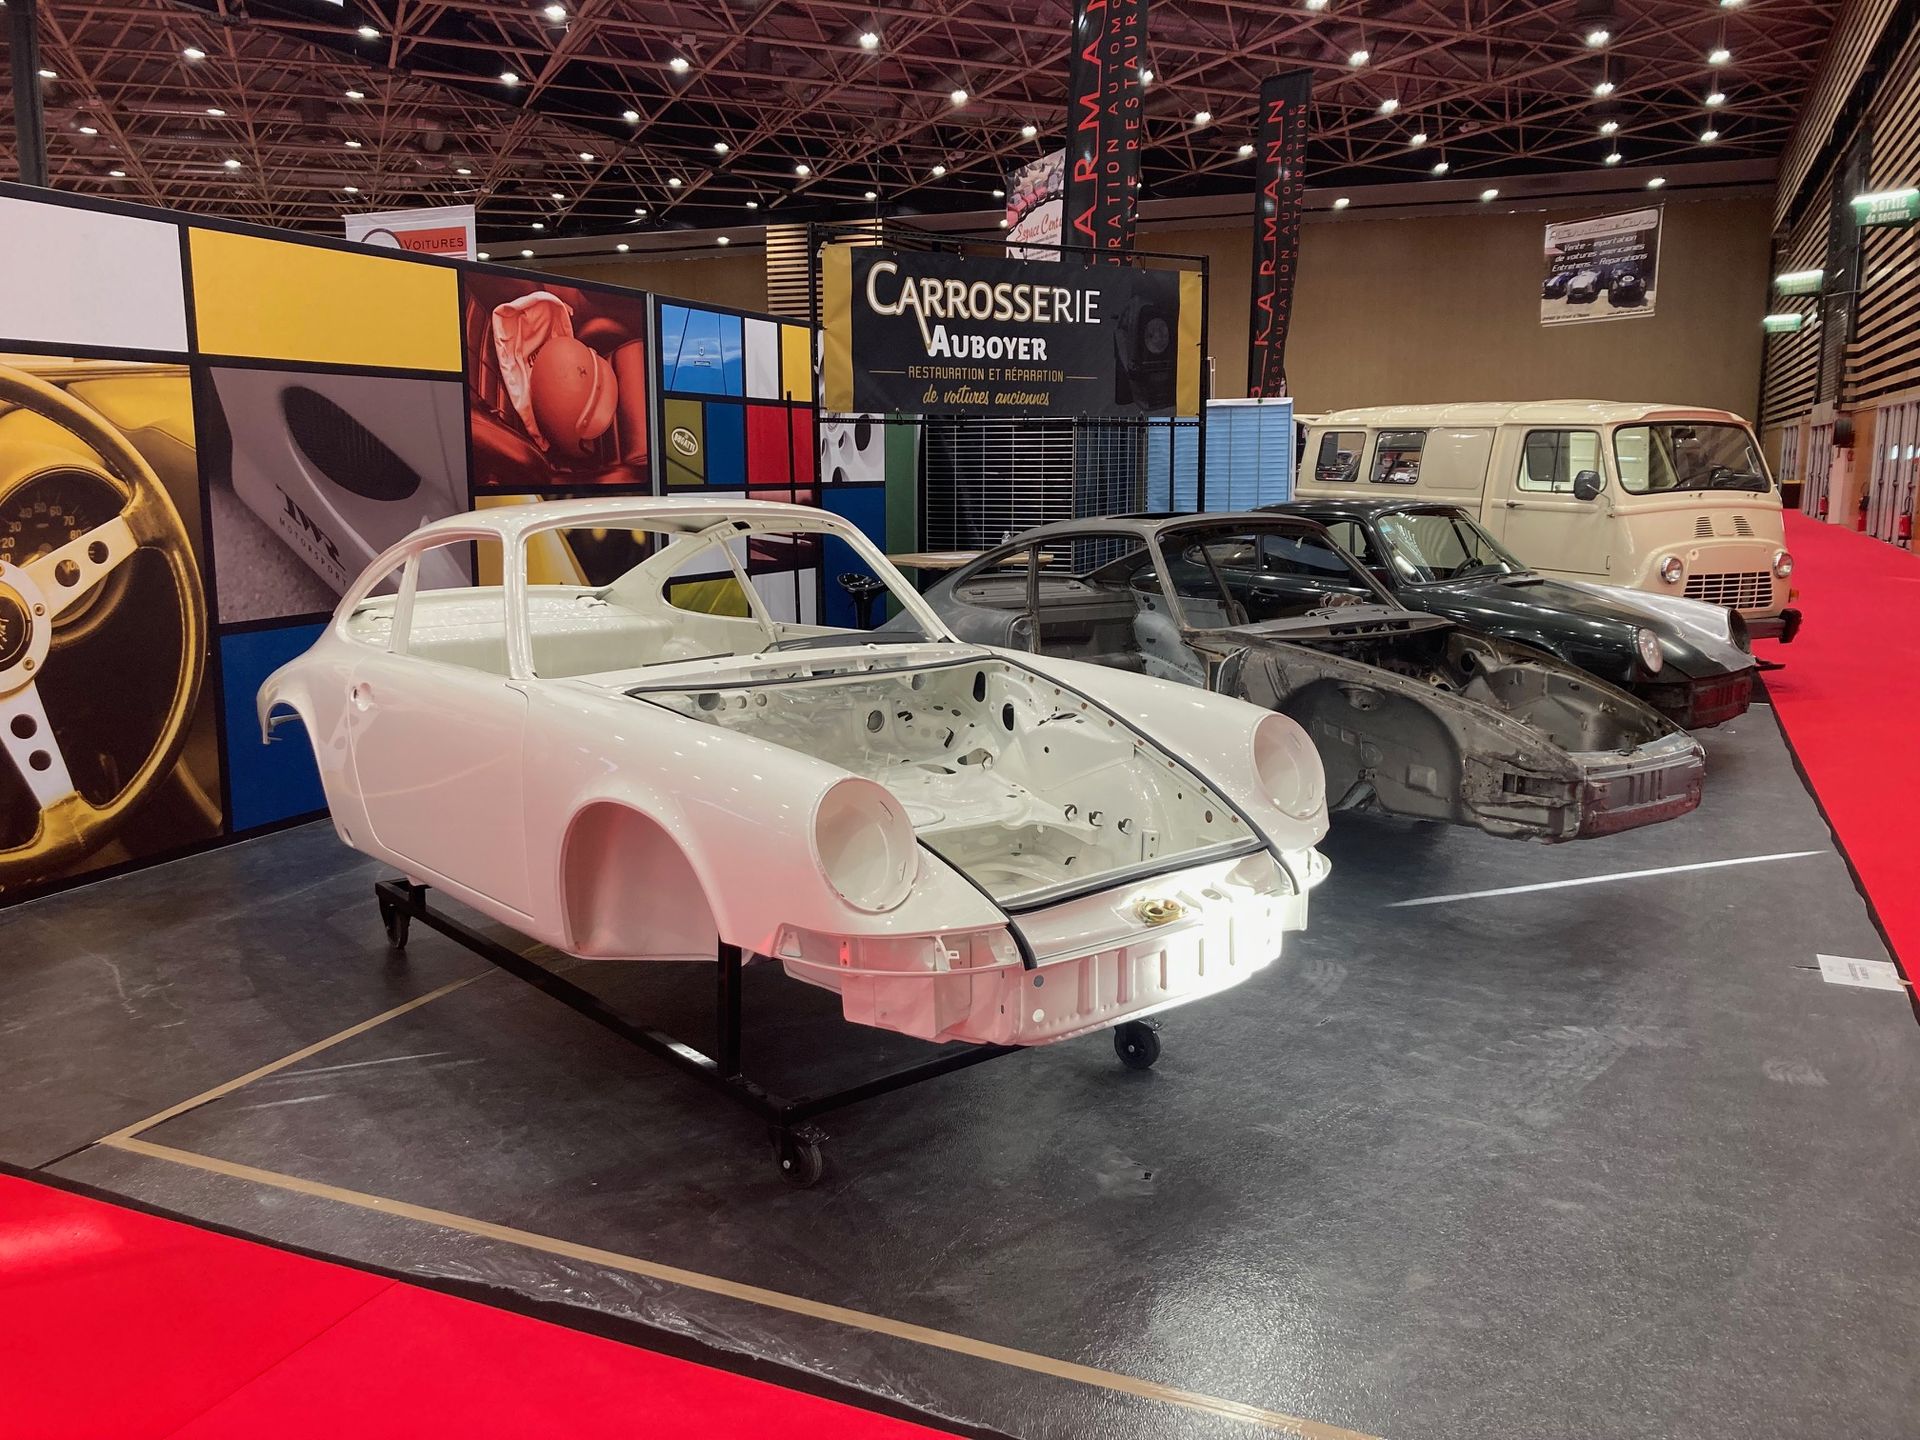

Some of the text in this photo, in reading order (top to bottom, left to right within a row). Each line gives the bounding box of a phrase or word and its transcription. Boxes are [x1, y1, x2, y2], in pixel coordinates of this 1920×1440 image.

[1041, 213, 1062, 234] Cent
[1254, 100, 1285, 346] KARMANN
[927, 325, 1047, 361] AUBOYER
[908, 366, 1064, 382] RESTAURATION ET RÉPARATION
[923, 384, 1050, 406] de voitures anciennes
[8, 521, 22, 533] 30
[63, 516, 75, 526] 70
[1, 537, 15, 549] 20
